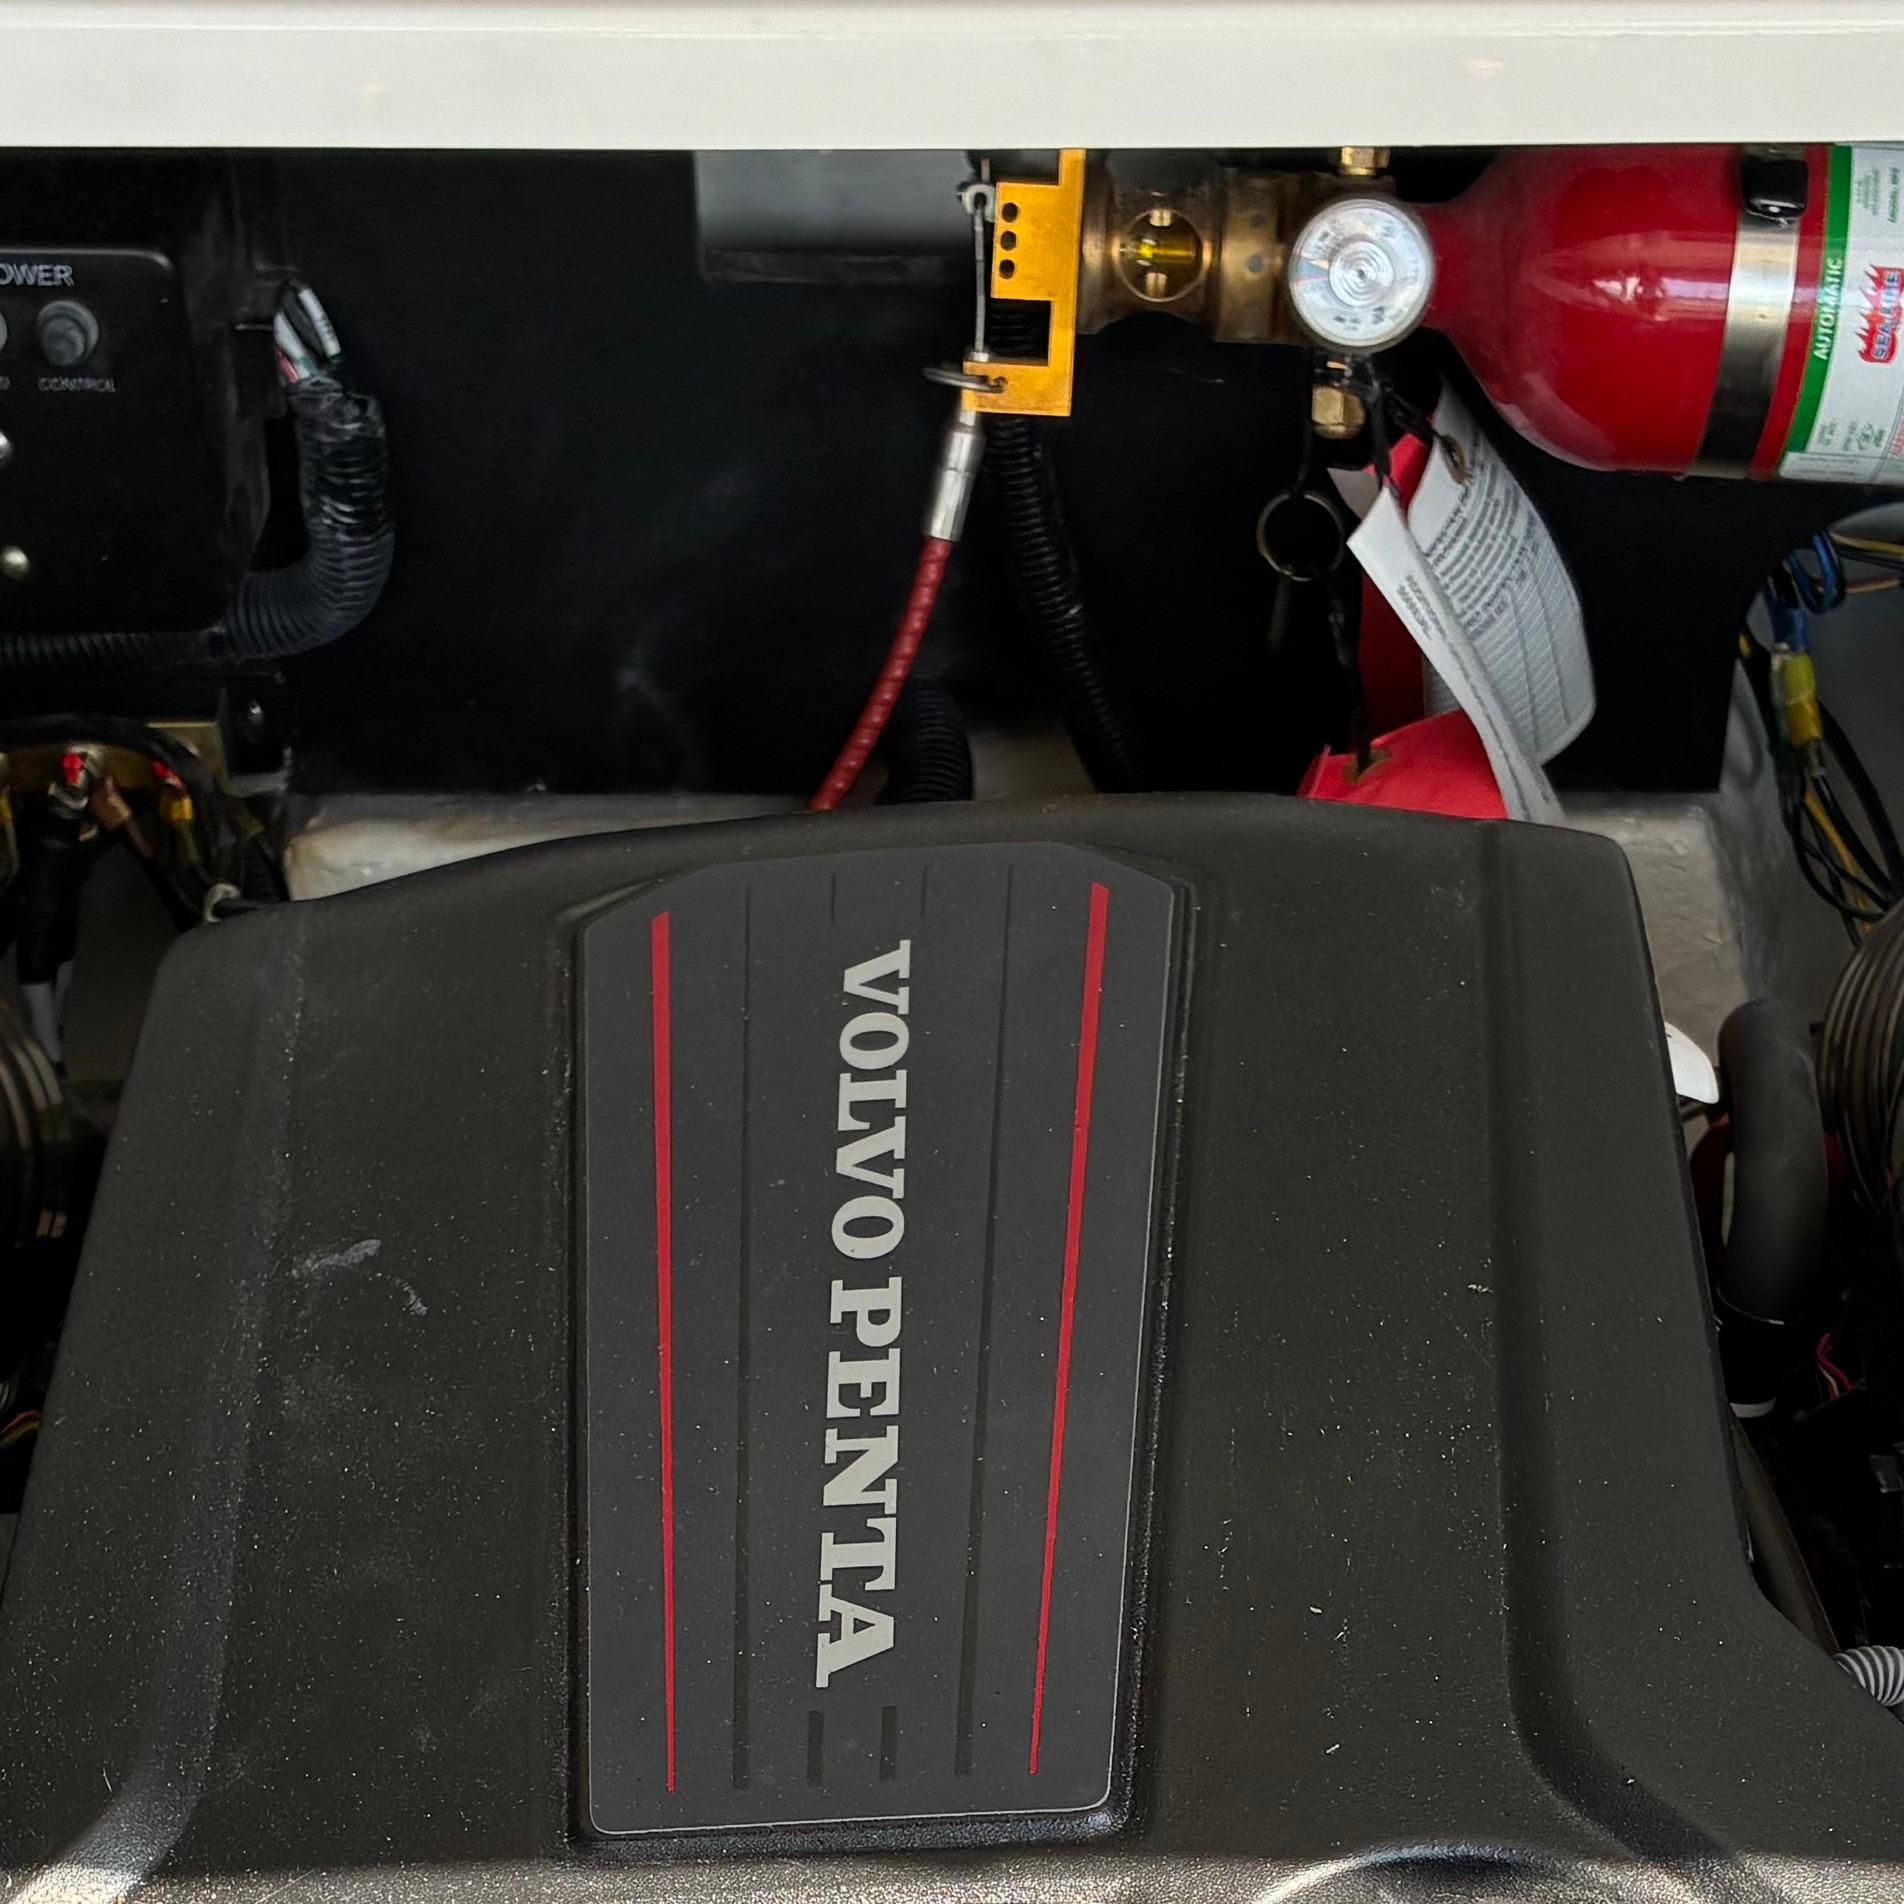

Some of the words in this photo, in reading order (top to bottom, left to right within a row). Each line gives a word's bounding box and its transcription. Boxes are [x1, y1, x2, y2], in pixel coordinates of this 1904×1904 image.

[1812, 257, 1842, 360] AUTOMATIC
[828, 939, 910, 1259] VOLVO
[814, 1277, 902, 1689] PENTA
